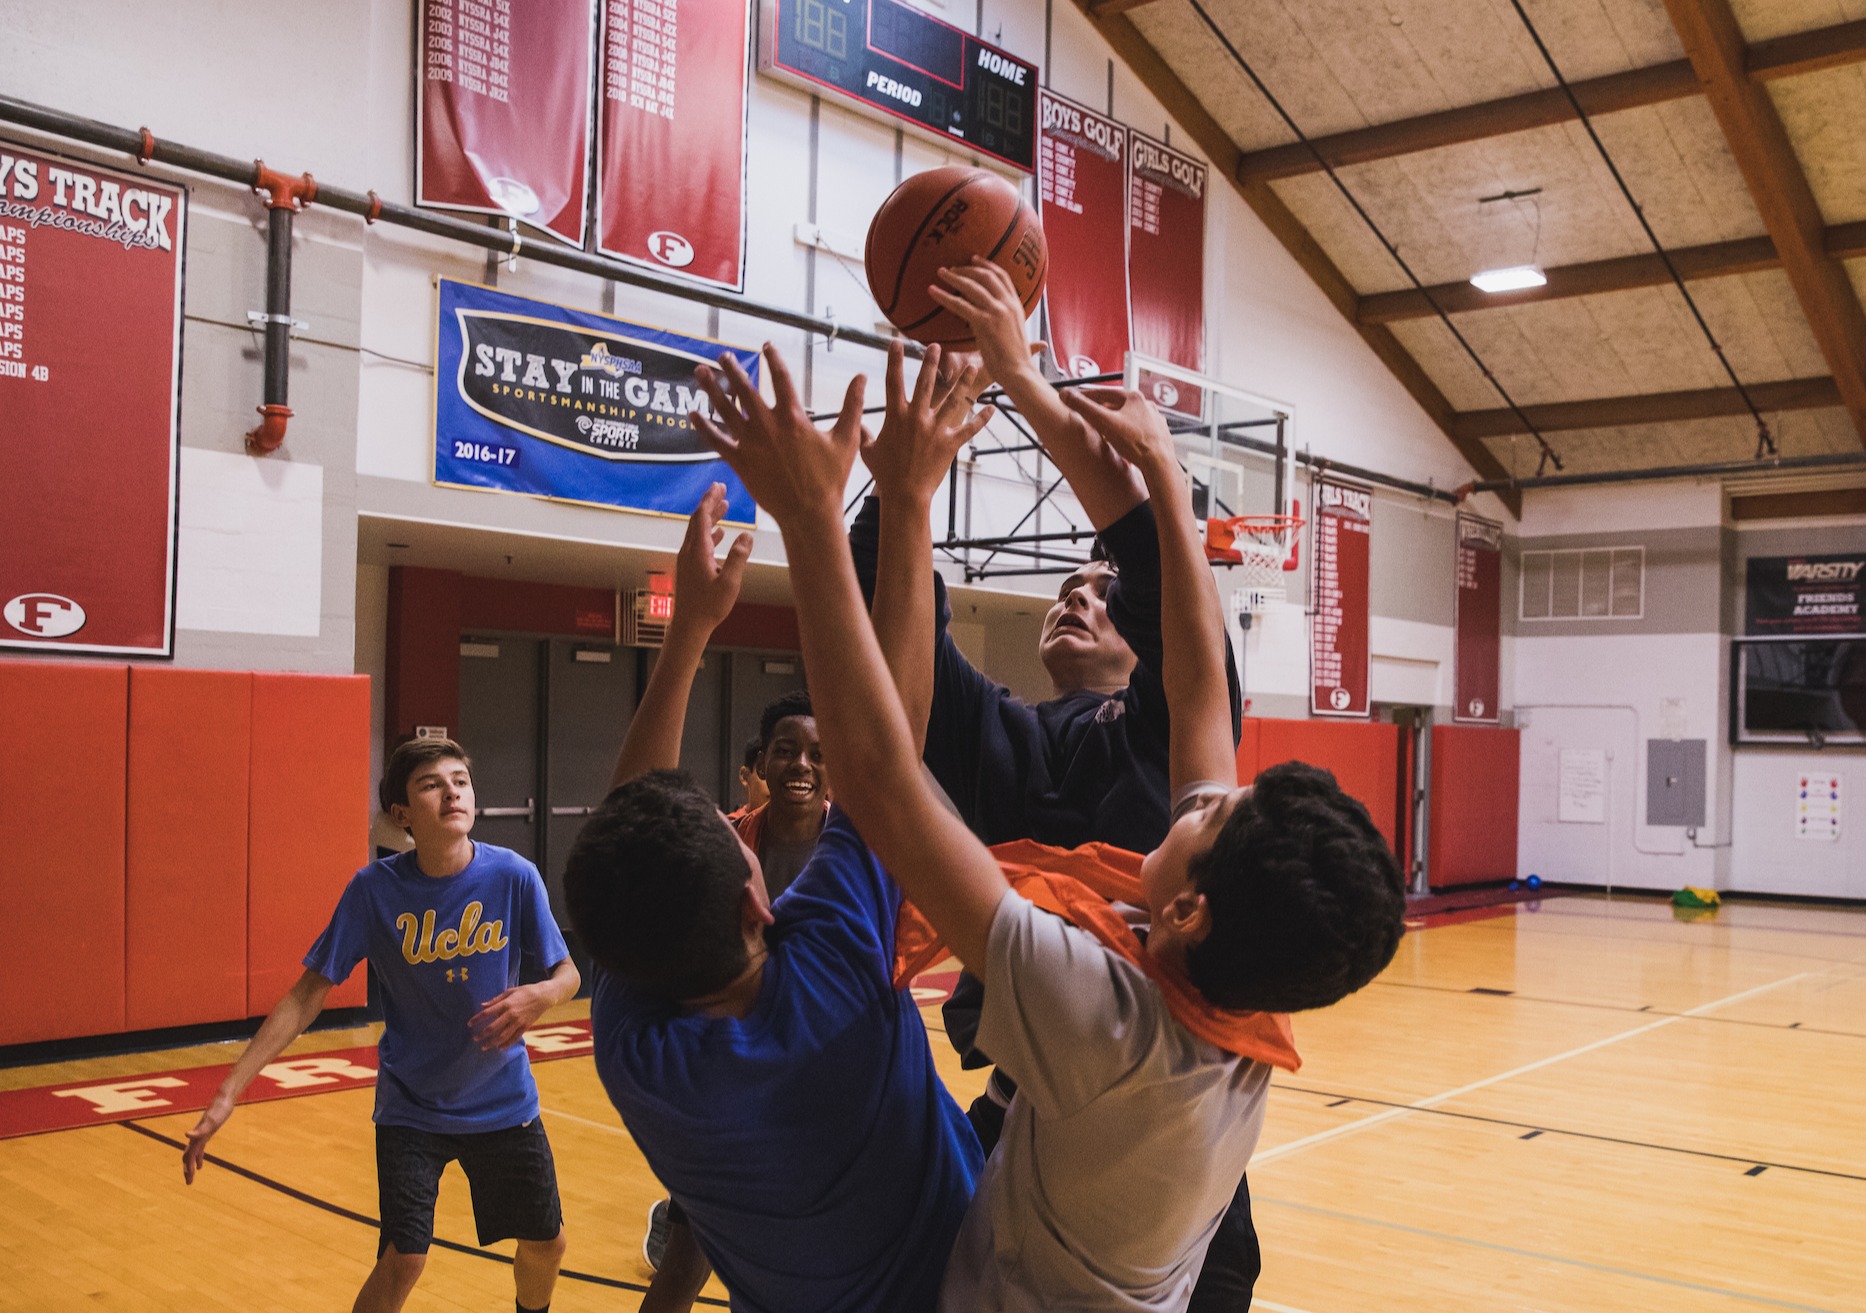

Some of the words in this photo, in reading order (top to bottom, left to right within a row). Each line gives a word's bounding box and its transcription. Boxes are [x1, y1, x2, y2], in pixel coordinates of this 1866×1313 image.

[428, 4, 452, 21] 2002
[428, 20, 452, 37] 2003
[428, 36, 452, 52] 2005
[428, 51, 452, 68] 2006
[978, 48, 1027, 87] HOME
[428, 67, 452, 82] 2009
[866, 71, 922, 108] PERIOD
[1042, 96, 1081, 133] BOYS
[1083, 117, 1124, 161] GOLF
[1133, 140, 1170, 173] GIRLS
[1172, 159, 1204, 199] GOLF
[49, 167, 172, 251] TRACK
[656, 235, 686, 261] F
[31, 365, 49, 382] 4B
[475, 343, 579, 394] STAY
[581, 375, 594, 395] IN
[599, 379, 620, 400] THE
[590, 348, 643, 375] NYSPHSAA
[492, 383, 637, 419] SPORTSMANSHIP
[591, 423, 639, 443] SPORTS
[454, 441, 516, 466] 2016-17
[1787, 561, 1865, 580] VARSITY
[650, 595, 672, 618] EXIT
[1793, 604, 1859, 616] ACADEMY
[1797, 592, 1855, 604] FRIENDS
[19, 596, 72, 633] F
[396, 901, 509, 965] Ucla
